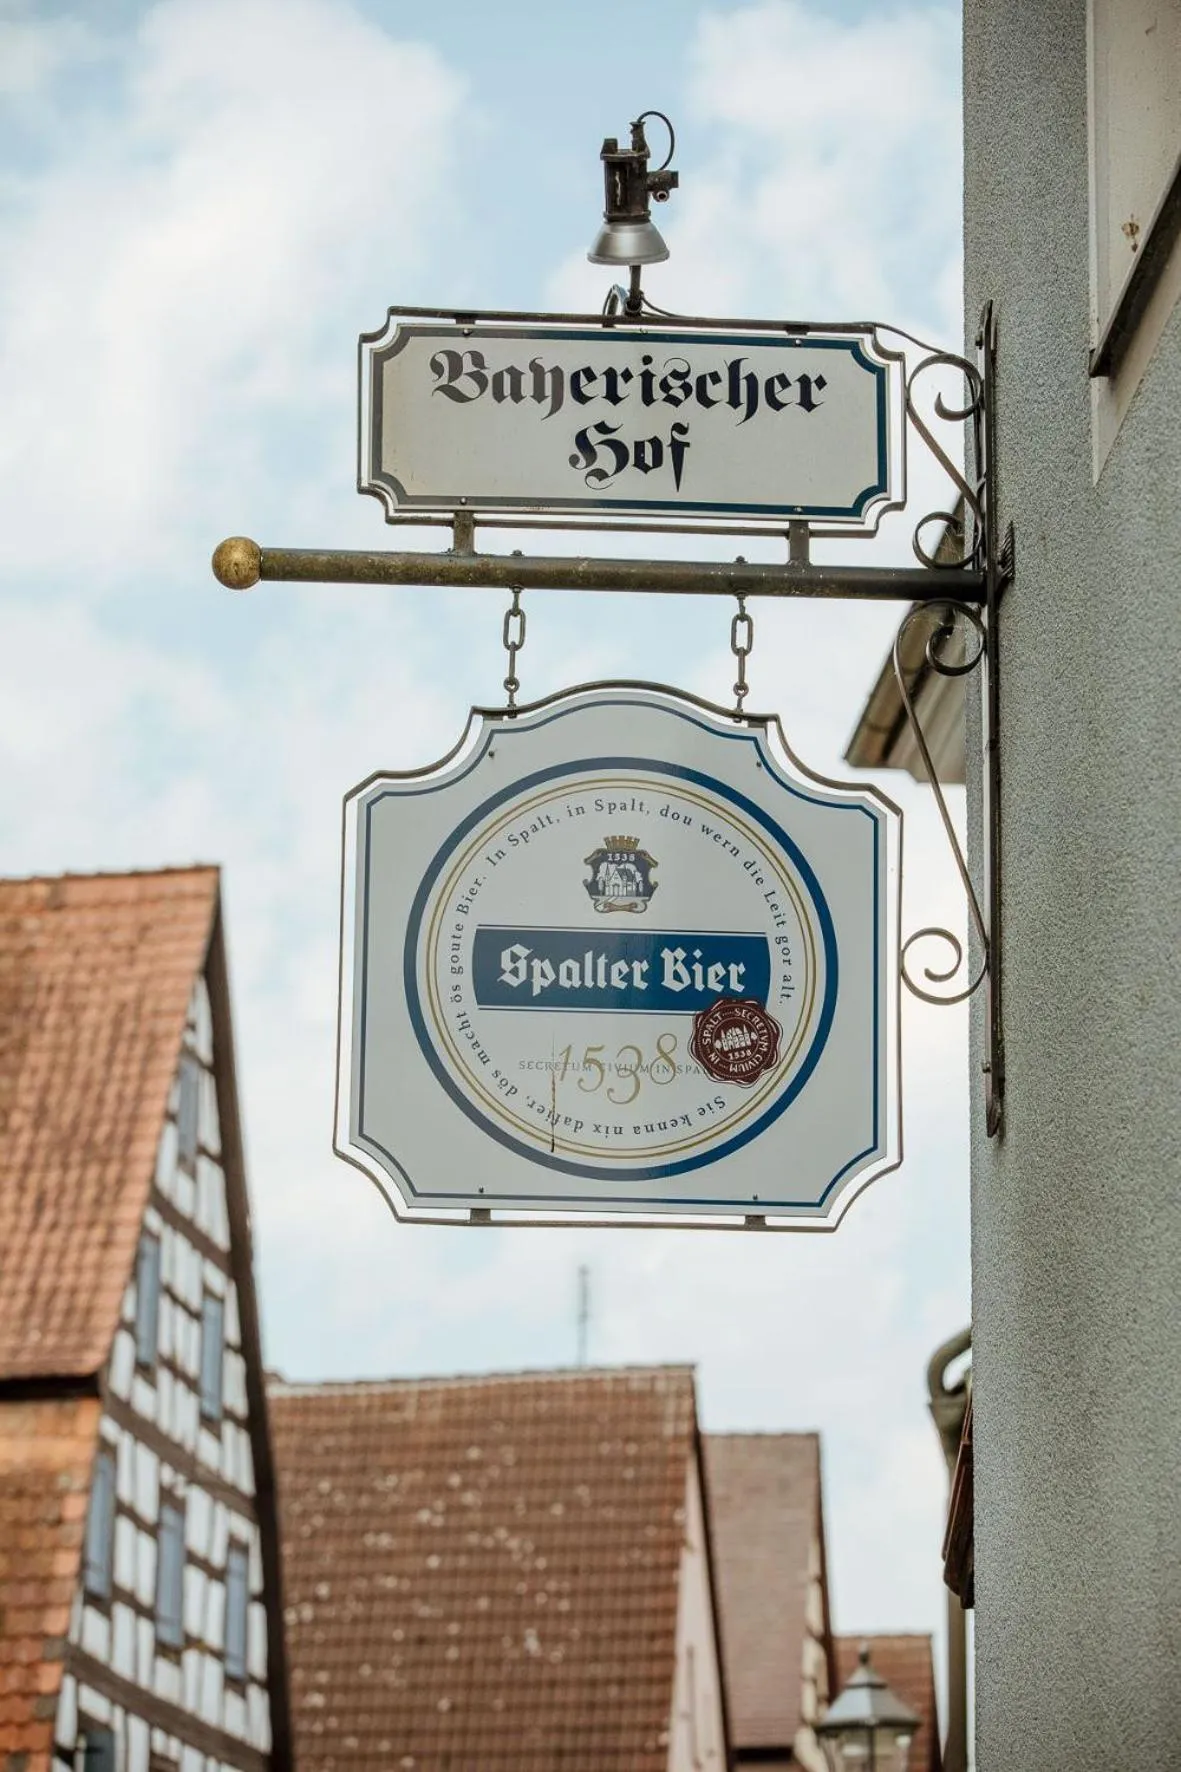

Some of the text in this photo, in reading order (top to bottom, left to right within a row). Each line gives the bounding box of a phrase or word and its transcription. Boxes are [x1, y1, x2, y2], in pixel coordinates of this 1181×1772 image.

[429, 349, 827, 426] Bayerischer
[568, 420, 690, 492] Hof
[567, 803, 586, 817] in
[594, 798, 650, 815] Spalt,
[660, 804, 692, 827] dou
[507, 815, 560, 847] Spalt,
[700, 824, 741, 857] wern
[485, 848, 506, 868] In
[607, 853, 636, 861] 1538
[743, 859, 765, 887] die
[456, 874, 486, 915] Bier.
[763, 890, 787, 928] Leit
[450, 923, 465, 974] goute
[775, 936, 793, 965] gor
[497, 943, 746, 996] Spalter Bier
[451, 984, 462, 1003] ös
[781, 974, 795, 1005] alt.
[456, 1010, 490, 1066] macht
[703, 1012, 723, 1045] SPALT
[558, 1034, 678, 1104] 1538
[728, 1050, 751, 1060] 1538
[492, 1069, 518, 1097] dös
[698, 1095, 726, 1116] Sie
[593, 1127, 623, 1139] nix
[632, 1113, 692, 1135] kenna
